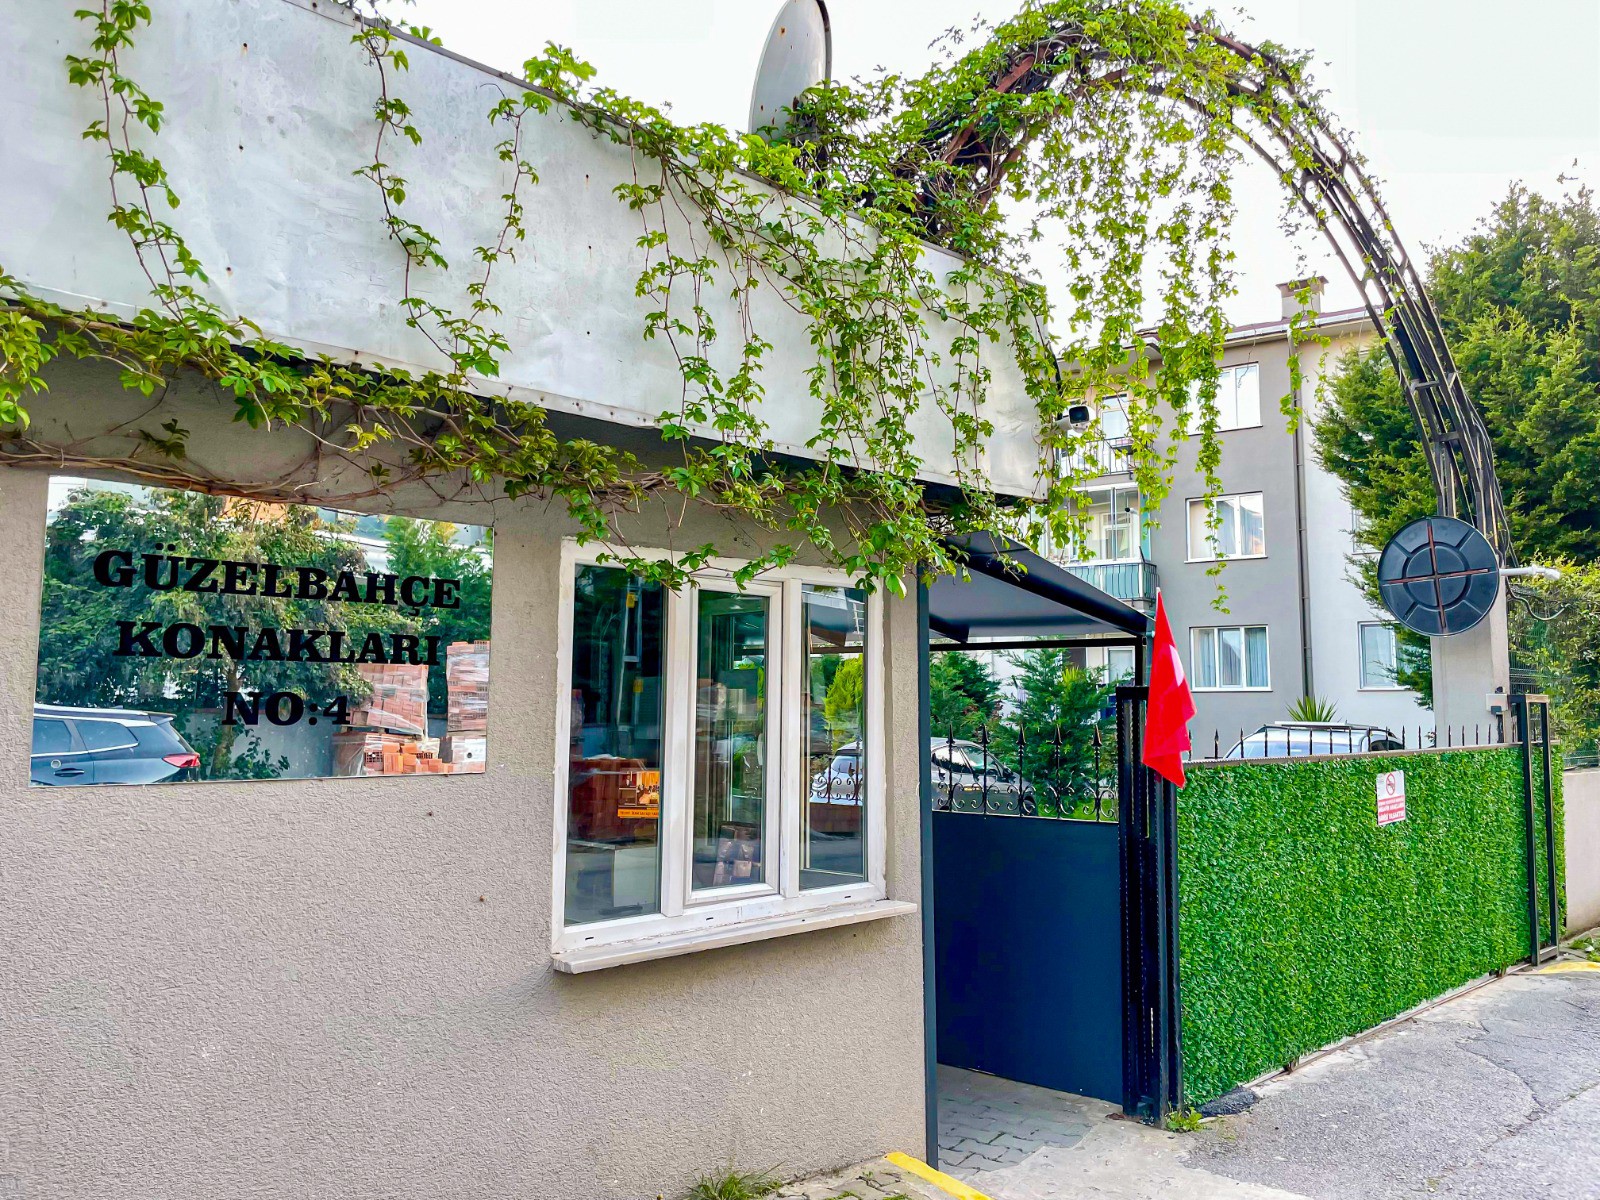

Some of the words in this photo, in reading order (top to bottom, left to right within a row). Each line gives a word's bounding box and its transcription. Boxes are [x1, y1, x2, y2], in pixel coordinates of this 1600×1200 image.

[93, 543, 461, 616] GÜZELBAHÇE
[113, 620, 440, 666] KONAKLARI
[221, 691, 351, 726] NO:4
